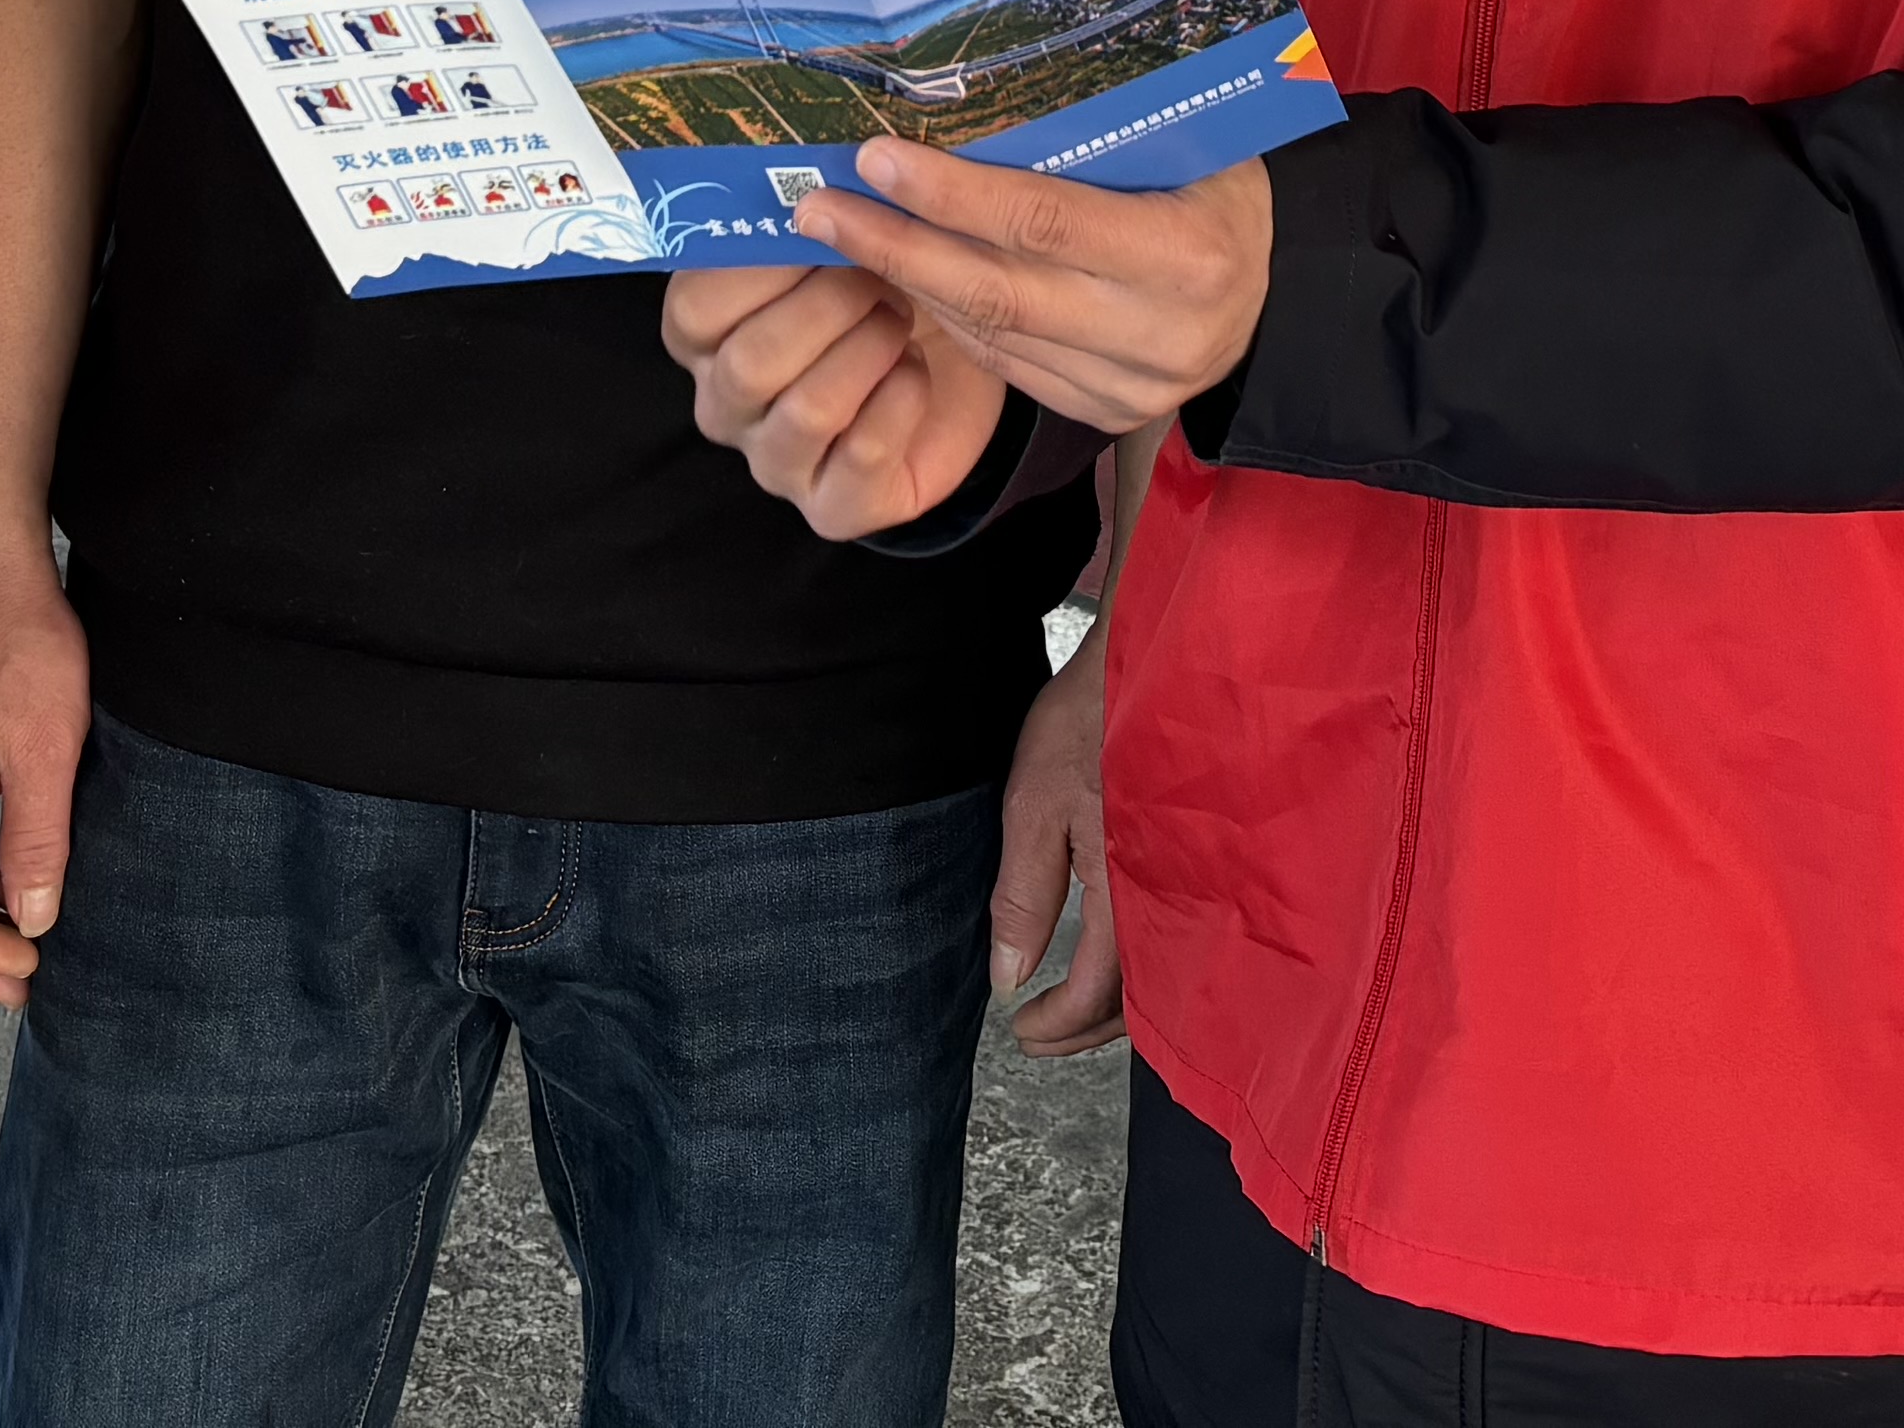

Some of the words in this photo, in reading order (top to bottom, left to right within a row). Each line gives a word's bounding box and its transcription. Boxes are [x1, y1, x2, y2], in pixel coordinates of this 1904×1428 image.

[332, 132, 551, 173] 灭火器的使用方法
